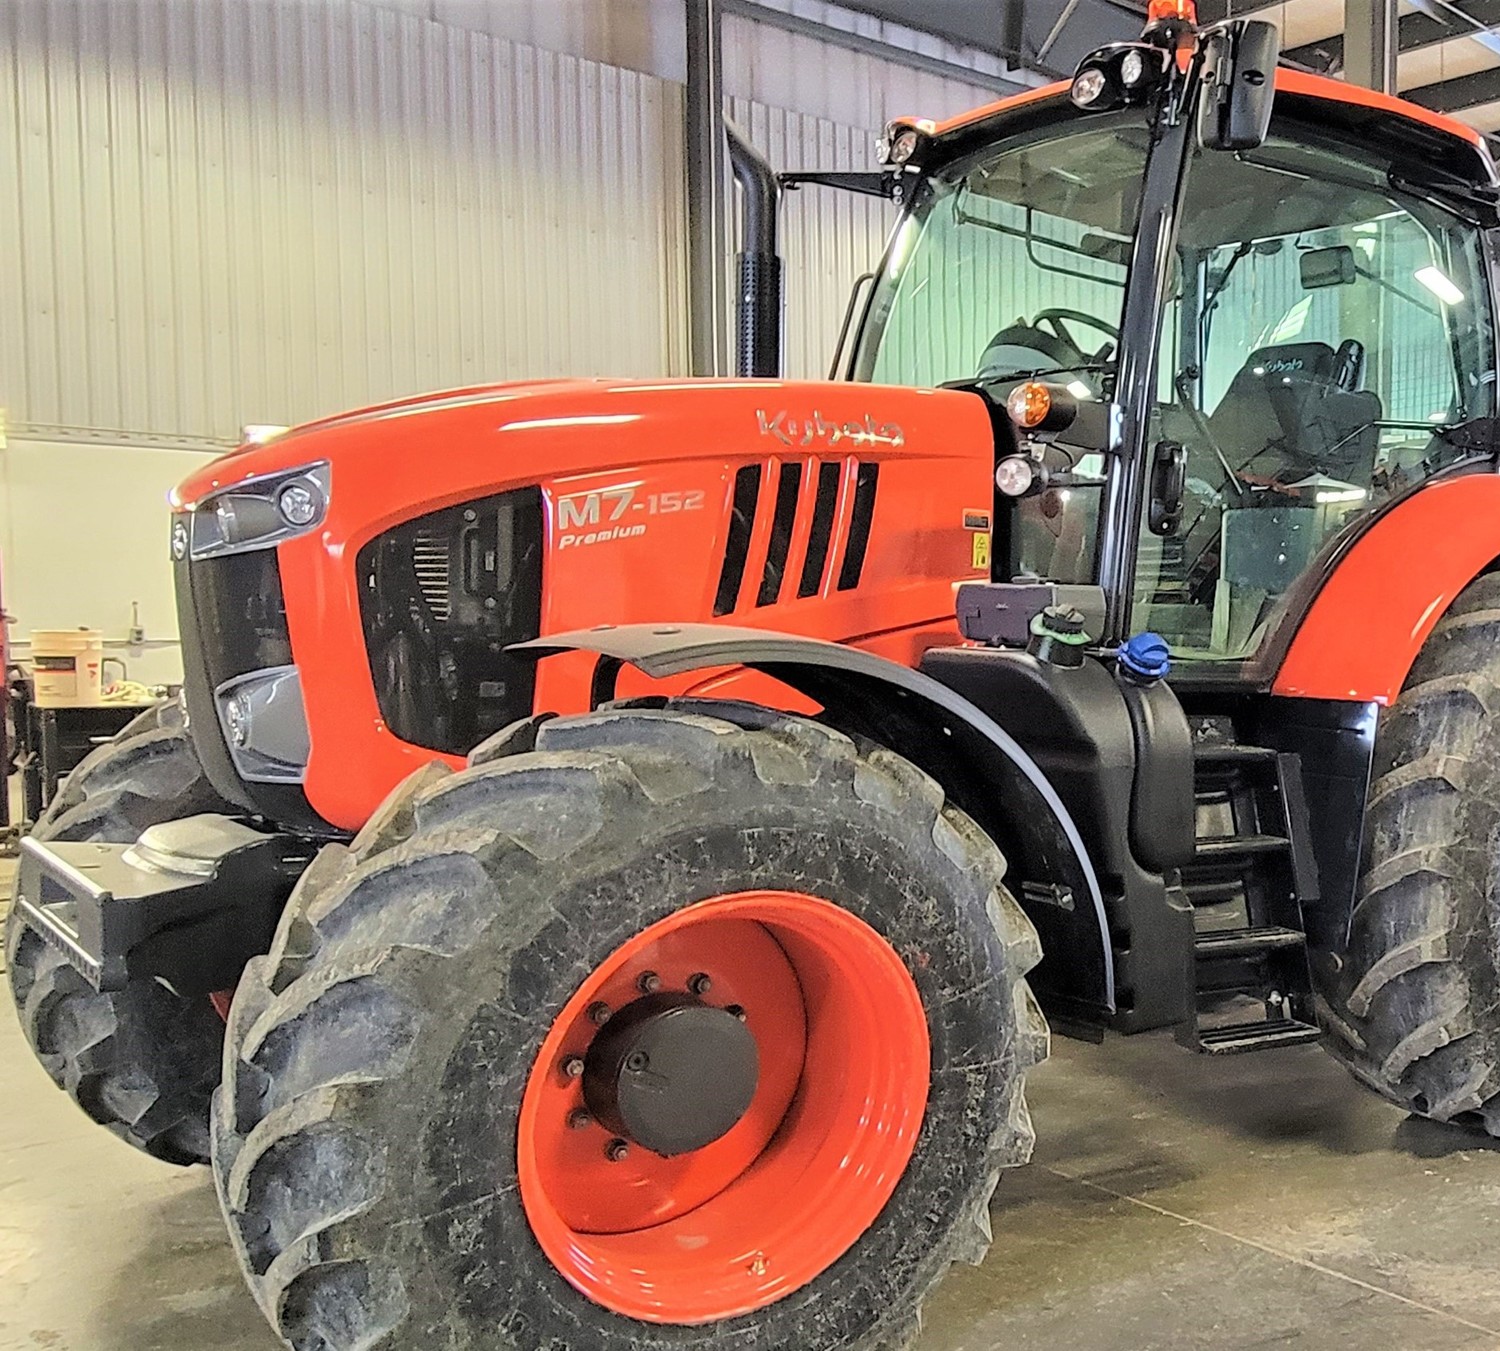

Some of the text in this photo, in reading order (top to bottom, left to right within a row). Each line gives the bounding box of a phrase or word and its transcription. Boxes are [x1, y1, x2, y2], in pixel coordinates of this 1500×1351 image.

[756, 409, 905, 447] Kubota
[558, 489, 705, 530] M7-152
[558, 524, 646, 550] Premium
